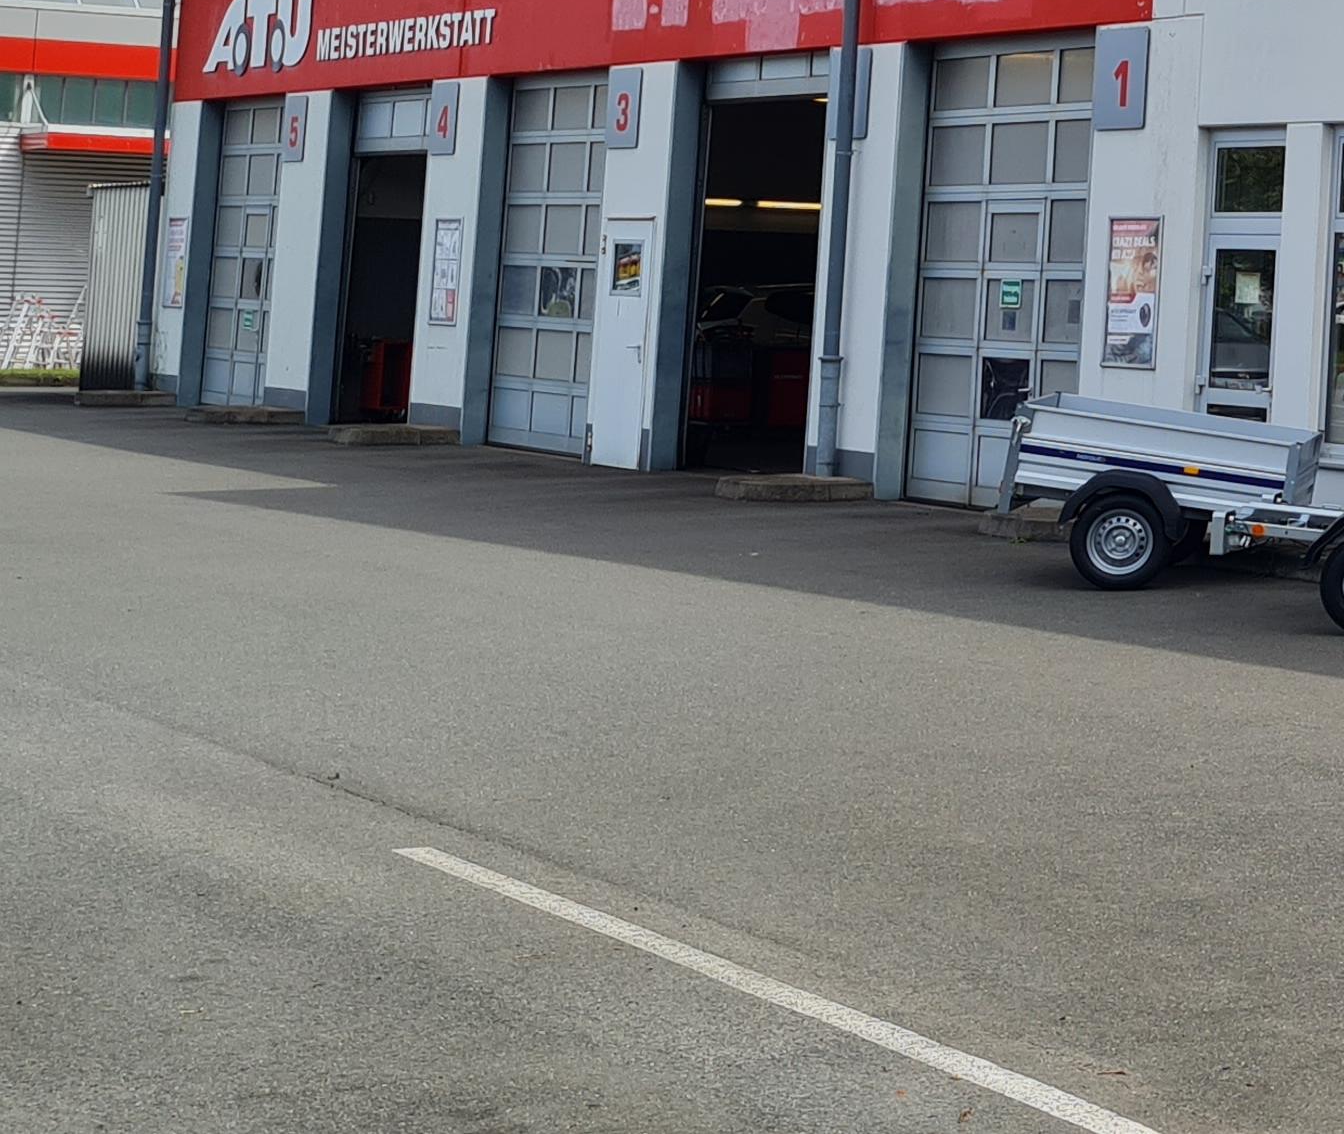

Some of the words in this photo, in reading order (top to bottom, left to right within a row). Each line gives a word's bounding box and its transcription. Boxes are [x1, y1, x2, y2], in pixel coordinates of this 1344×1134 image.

[316, 9, 496, 62] MEISTERWERKSTATT
[1114, 60, 1129, 107] 1
[289, 116, 299, 148] 5
[437, 105, 449, 139] 4
[616, 93, 630, 132] 3
